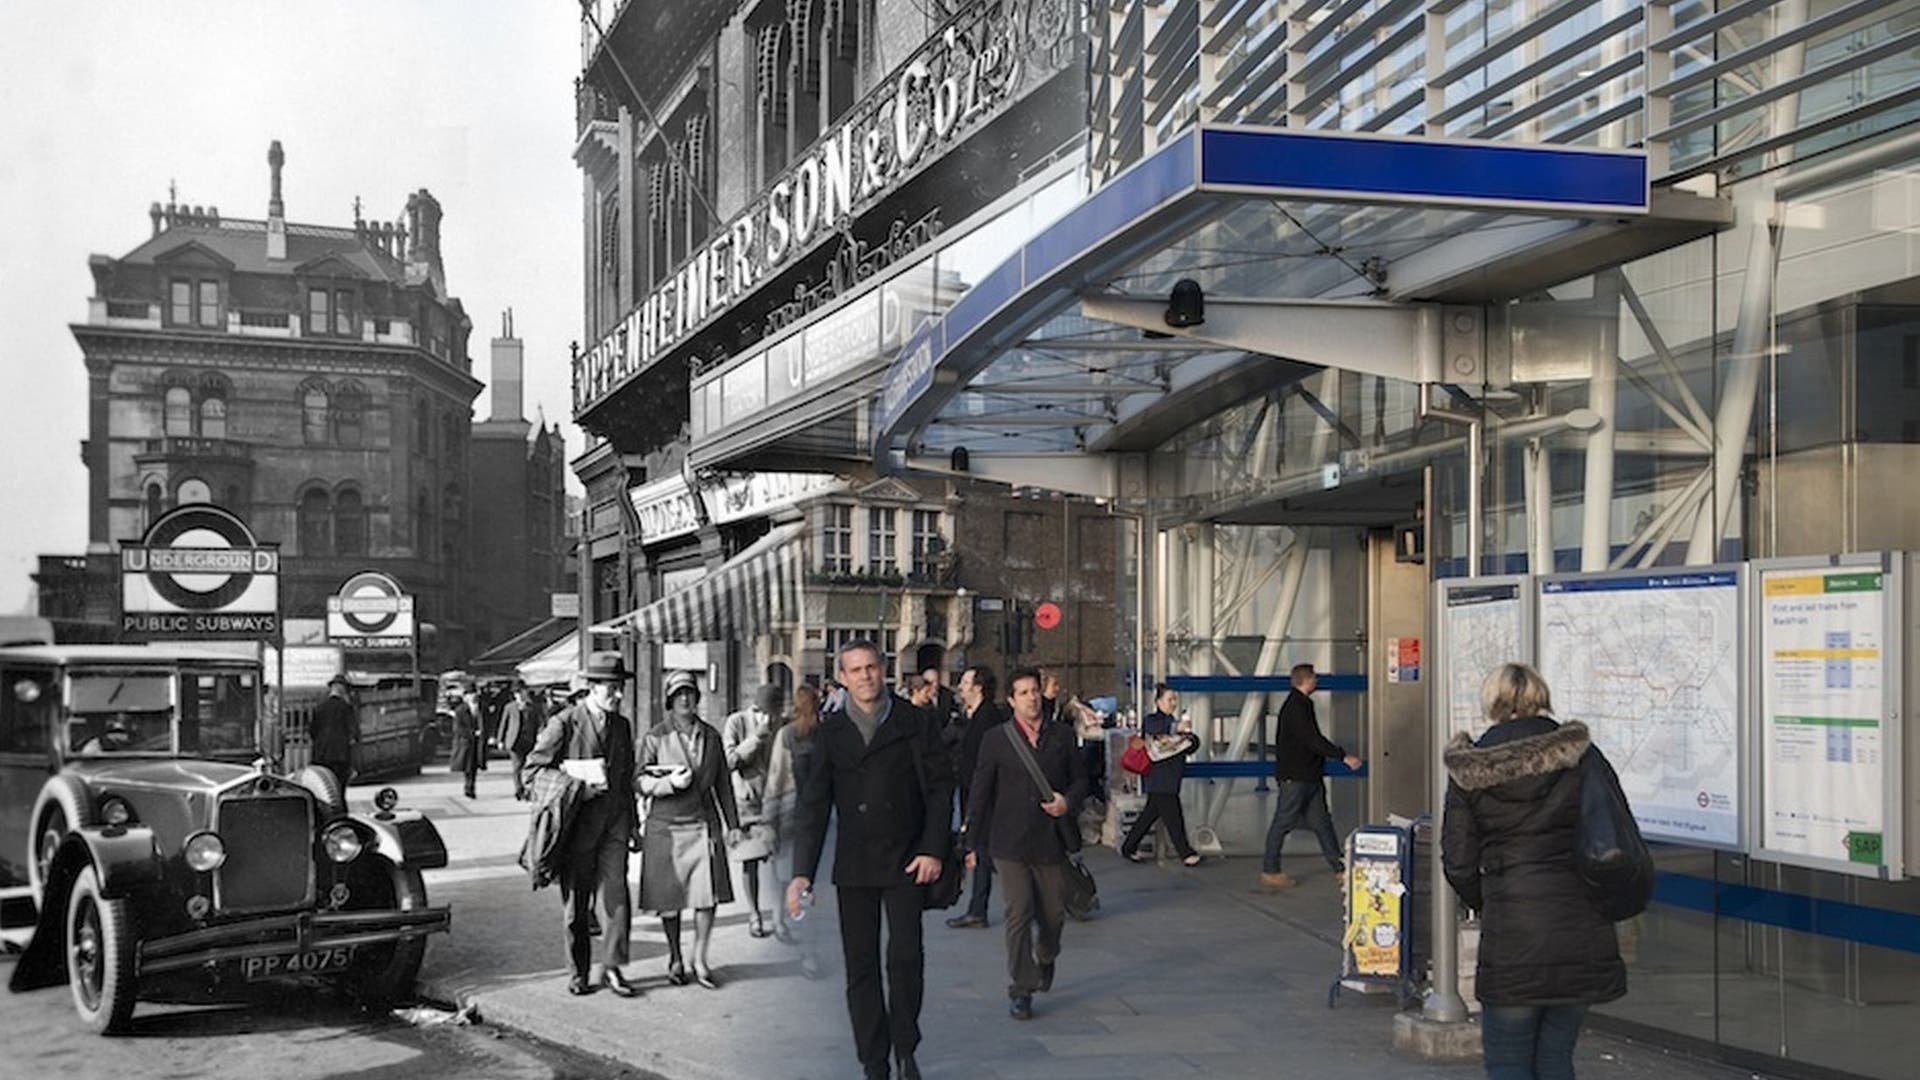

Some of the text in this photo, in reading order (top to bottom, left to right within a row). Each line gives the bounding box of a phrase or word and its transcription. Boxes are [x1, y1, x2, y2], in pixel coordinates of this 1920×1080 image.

[767, 122, 851, 262] SON
[128, 550, 272, 571] UNDERGROUND
[124, 616, 275, 631] PUBLIC SUBWAYS
[286, 948, 347, 970] 4075
